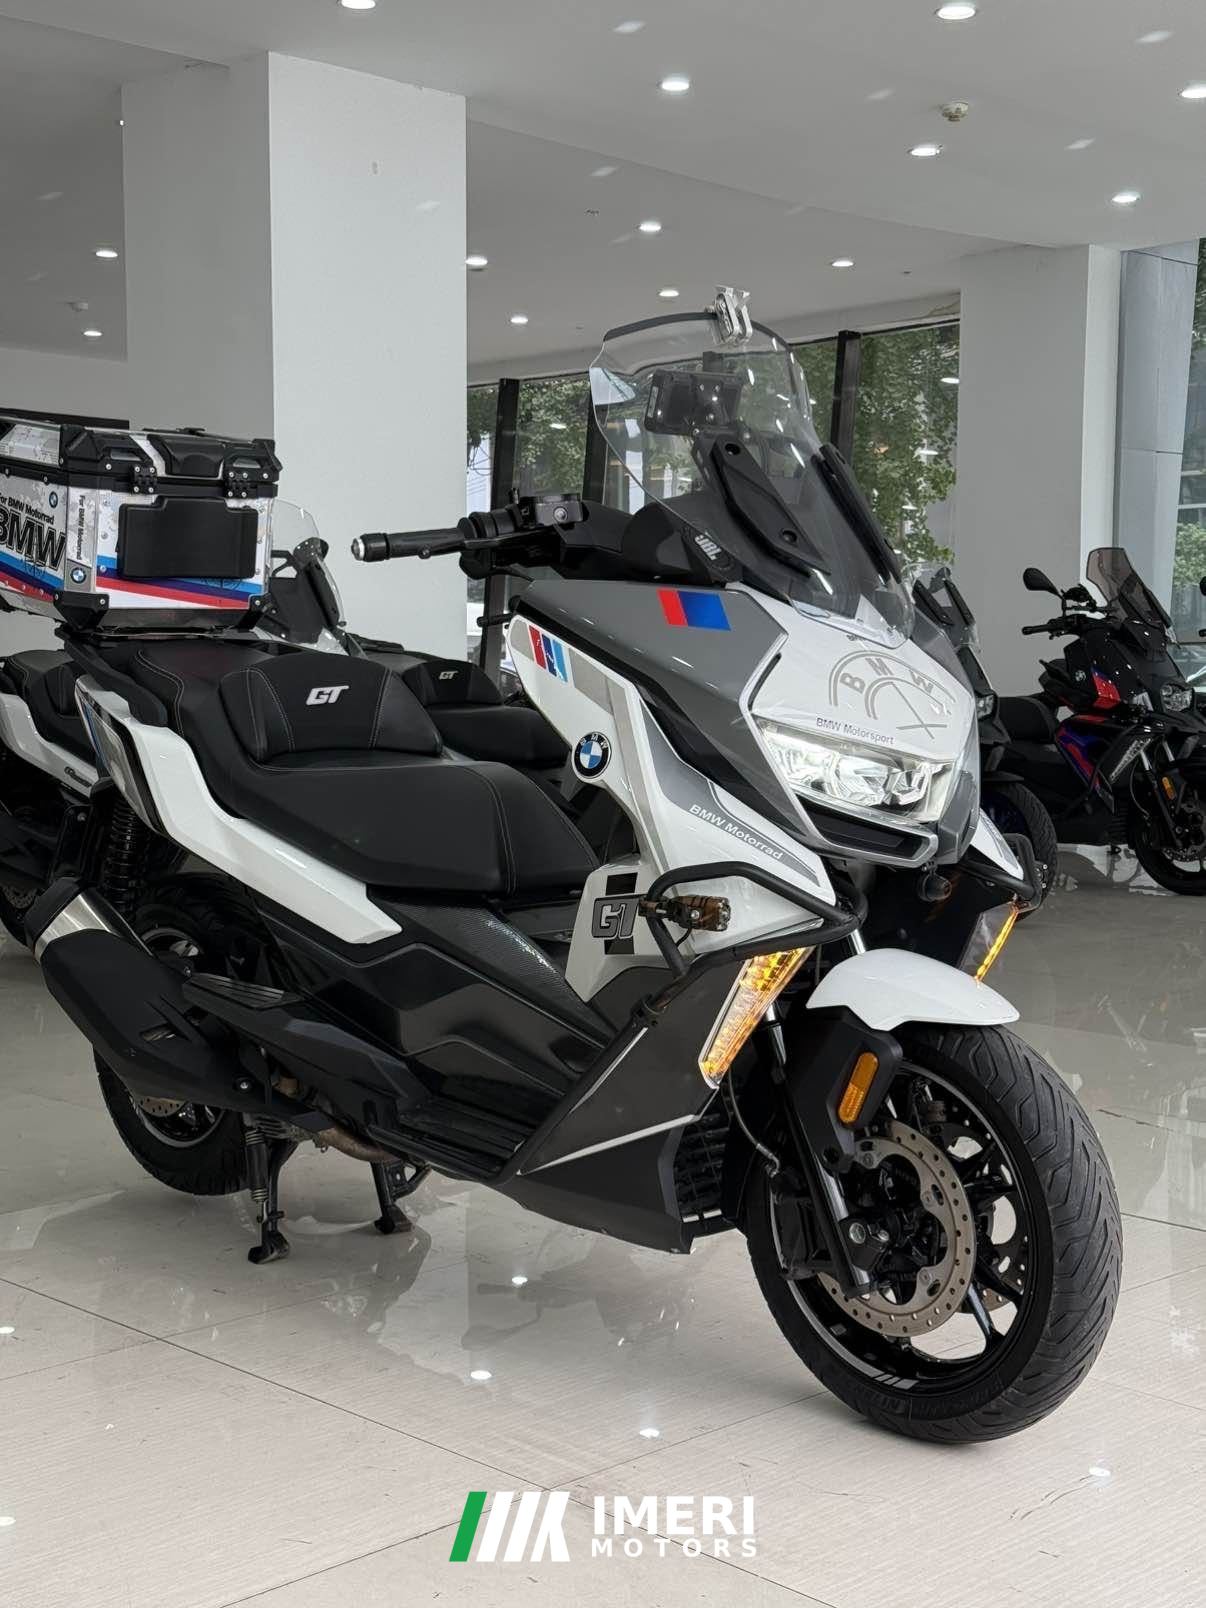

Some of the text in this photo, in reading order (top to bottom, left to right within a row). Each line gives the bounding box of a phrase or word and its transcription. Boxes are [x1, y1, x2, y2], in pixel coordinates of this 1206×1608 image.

[9, 497, 24, 511] BMW
[25, 504, 54, 525] Motorrad
[695, 534, 721, 560] JBL
[439, 671, 458, 680] GT
[306, 685, 349, 705] GT
[816, 717, 894, 745] BMW Motorsport
[689, 804, 783, 859] BMW Motorrad
